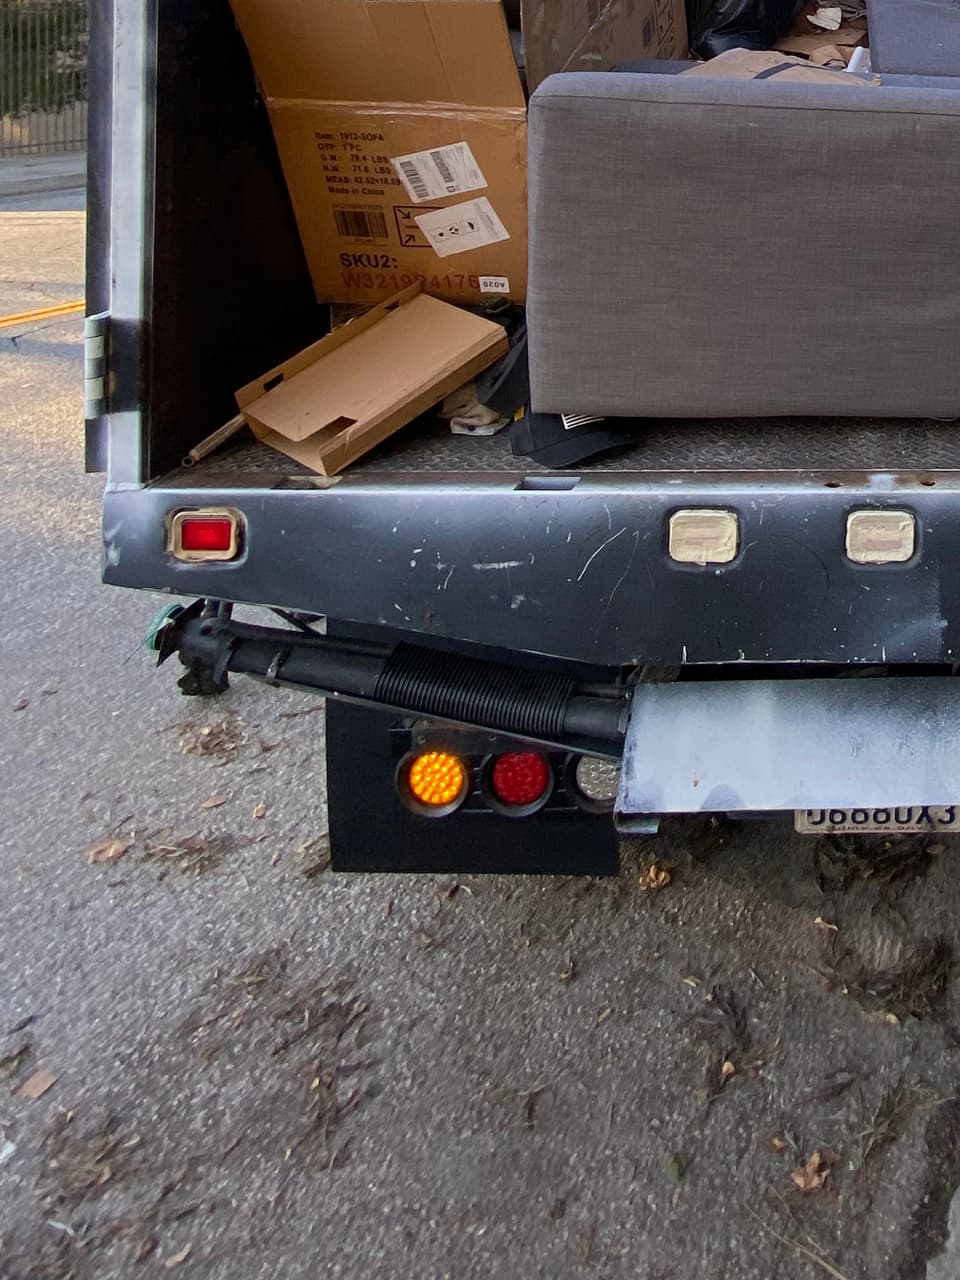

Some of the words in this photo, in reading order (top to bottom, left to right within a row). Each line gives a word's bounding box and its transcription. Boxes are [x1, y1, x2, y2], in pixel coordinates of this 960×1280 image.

[371, 156, 389, 164] LBS
[374, 167, 391, 175] LBS
[328, 186, 350, 195] Made
[361, 187, 385, 196] China
[340, 253, 398, 269] SKU2:
[482, 280, 505, 289] A020
